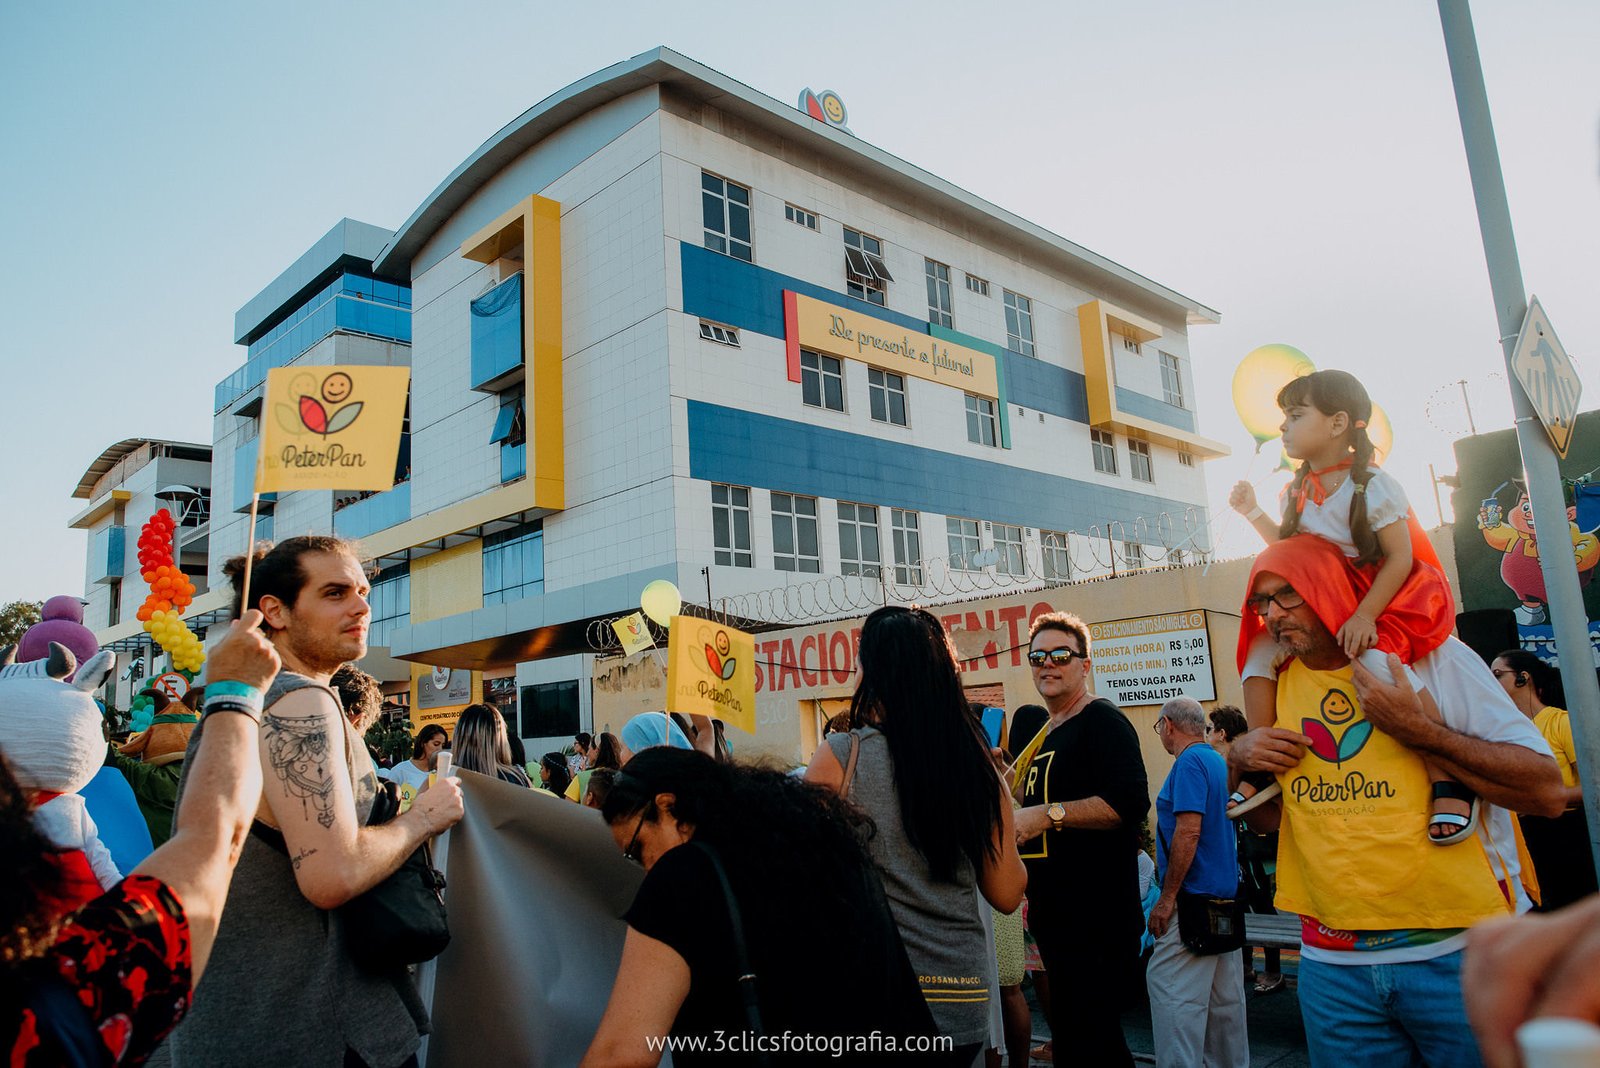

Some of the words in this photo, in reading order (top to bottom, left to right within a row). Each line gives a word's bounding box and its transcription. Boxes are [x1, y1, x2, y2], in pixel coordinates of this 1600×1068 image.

[829, 314, 854, 342] De
[858, 331, 916, 359] presente
[1103, 619, 1153, 638] ESTACIONAMENTO
[1093, 647, 1131, 658] HORISTA
[1133, 641, 1166, 657] (HORA)
[1184, 637, 1204, 650] 5,00
[1095, 662, 1129, 675] FRAÇÃO
[1130, 660, 1144, 673] (15
[1145, 658, 1168, 671] MIN.)
[1185, 655, 1204, 668] 1,25
[1106, 678, 1139, 689] TEMOS
[1140, 675, 1167, 686] VAGA
[1169, 673, 1196, 684] PARA
[1118, 687, 1184, 702] MENSALISTA
[760, 700, 789, 725] 310
[1311, 804, 1376, 817] ASSOCIAÇÃO
[918, 975, 959, 984] ROSSANA
